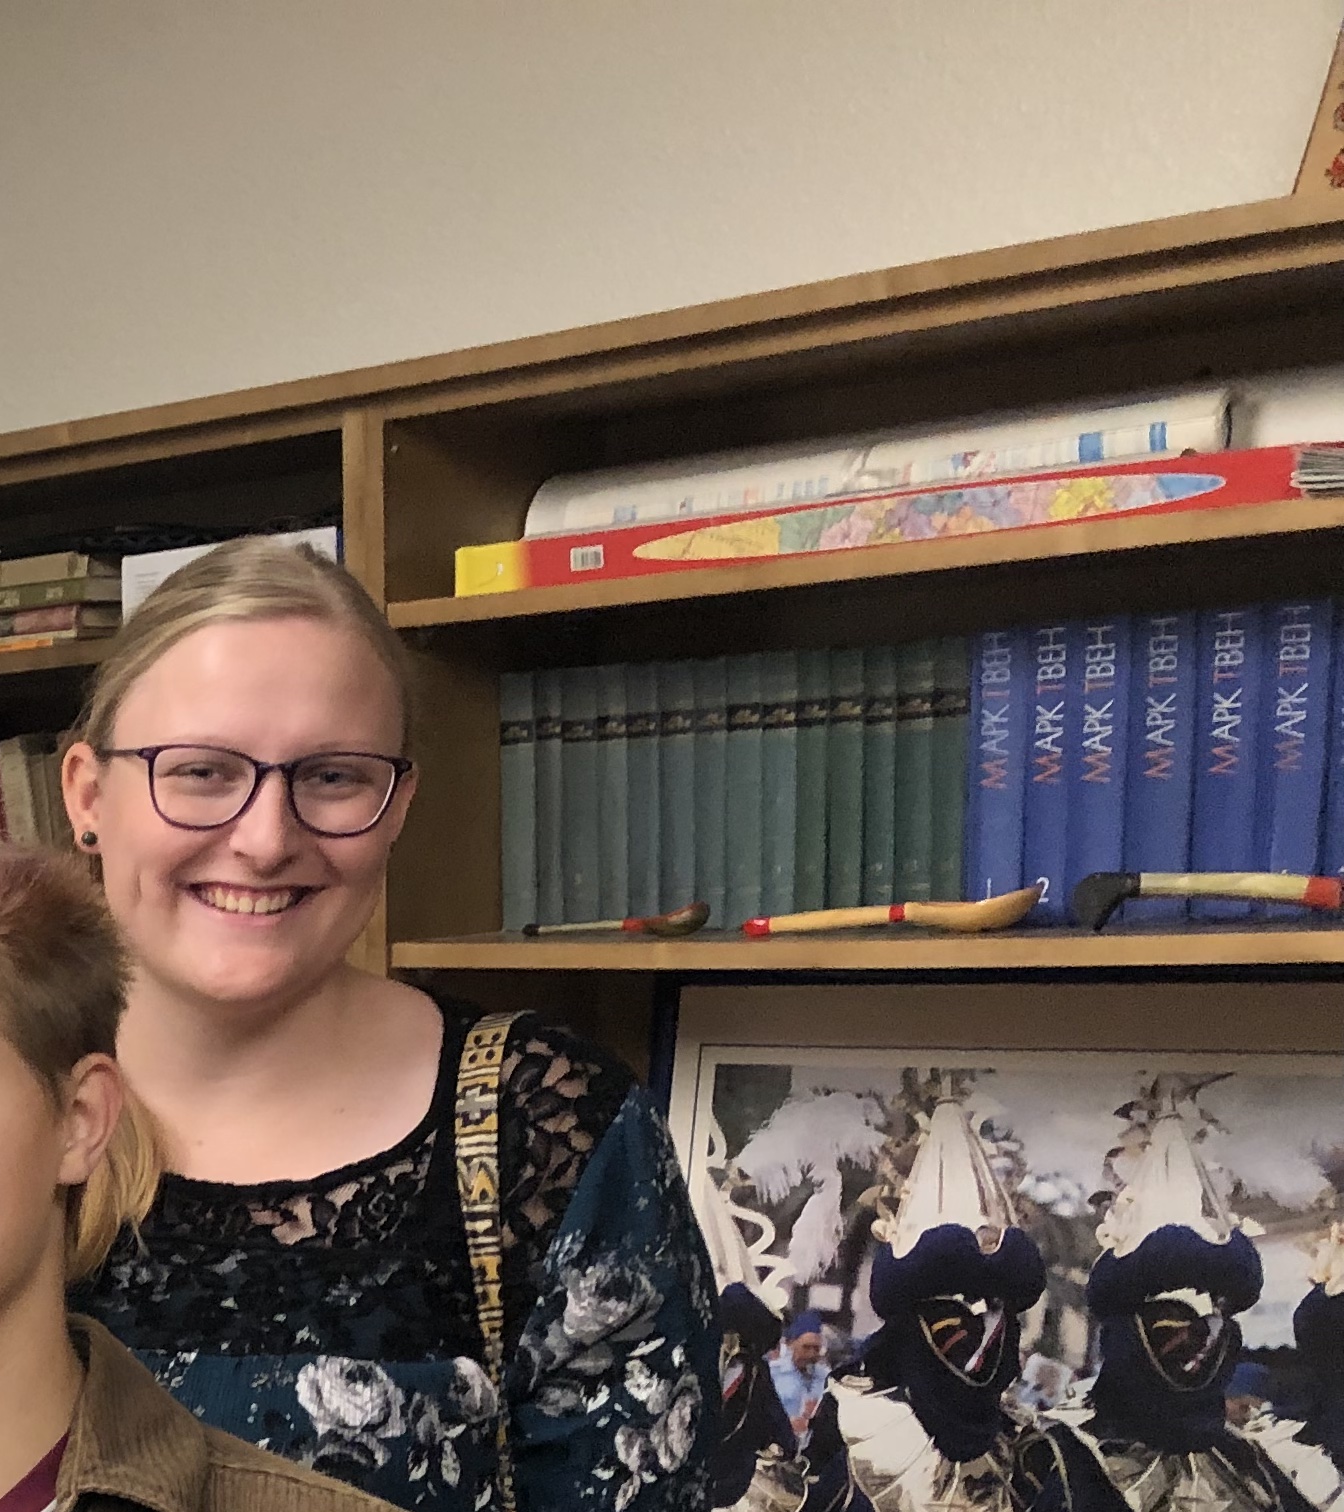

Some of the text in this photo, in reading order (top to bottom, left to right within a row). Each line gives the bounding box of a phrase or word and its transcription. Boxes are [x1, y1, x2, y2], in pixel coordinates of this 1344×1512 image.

[980, 704, 1009, 789] МАРК
[1033, 701, 1064, 784] МАРК
[1081, 698, 1113, 783] МАРК
[1143, 693, 1177, 780] МАРК
[1208, 688, 1243, 776] МАРК
[1274, 683, 1309, 771] МАРК
[1037, 877, 1049, 903] 2
